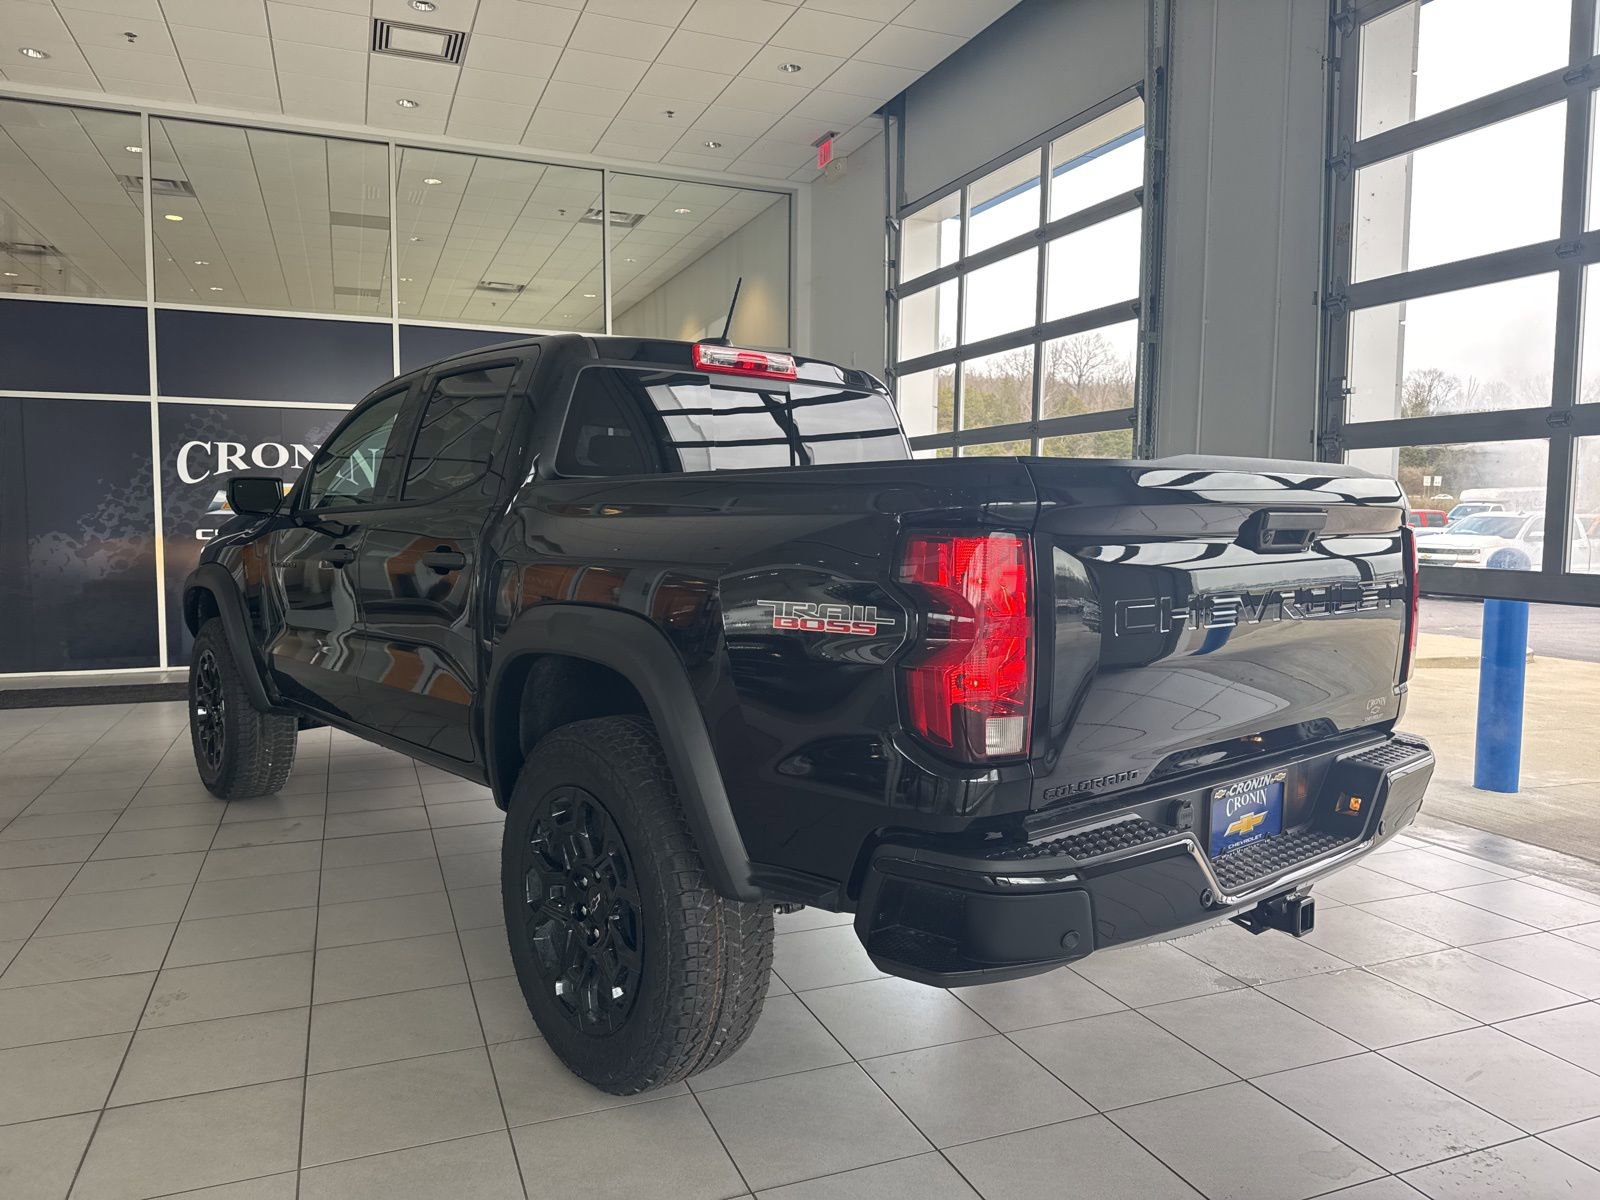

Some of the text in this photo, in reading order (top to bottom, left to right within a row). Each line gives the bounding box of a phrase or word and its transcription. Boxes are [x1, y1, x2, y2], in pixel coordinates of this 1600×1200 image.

[176, 440, 380, 488] CRONN
[757, 600, 895, 625] TRAIL
[1114, 578, 1399, 637] CHEVROLET
[773, 616, 877, 635] BOSS
[1043, 769, 1139, 800] COLORADO
[1229, 774, 1272, 797] CRONIN
[1226, 788, 1268, 817] CRONIN
